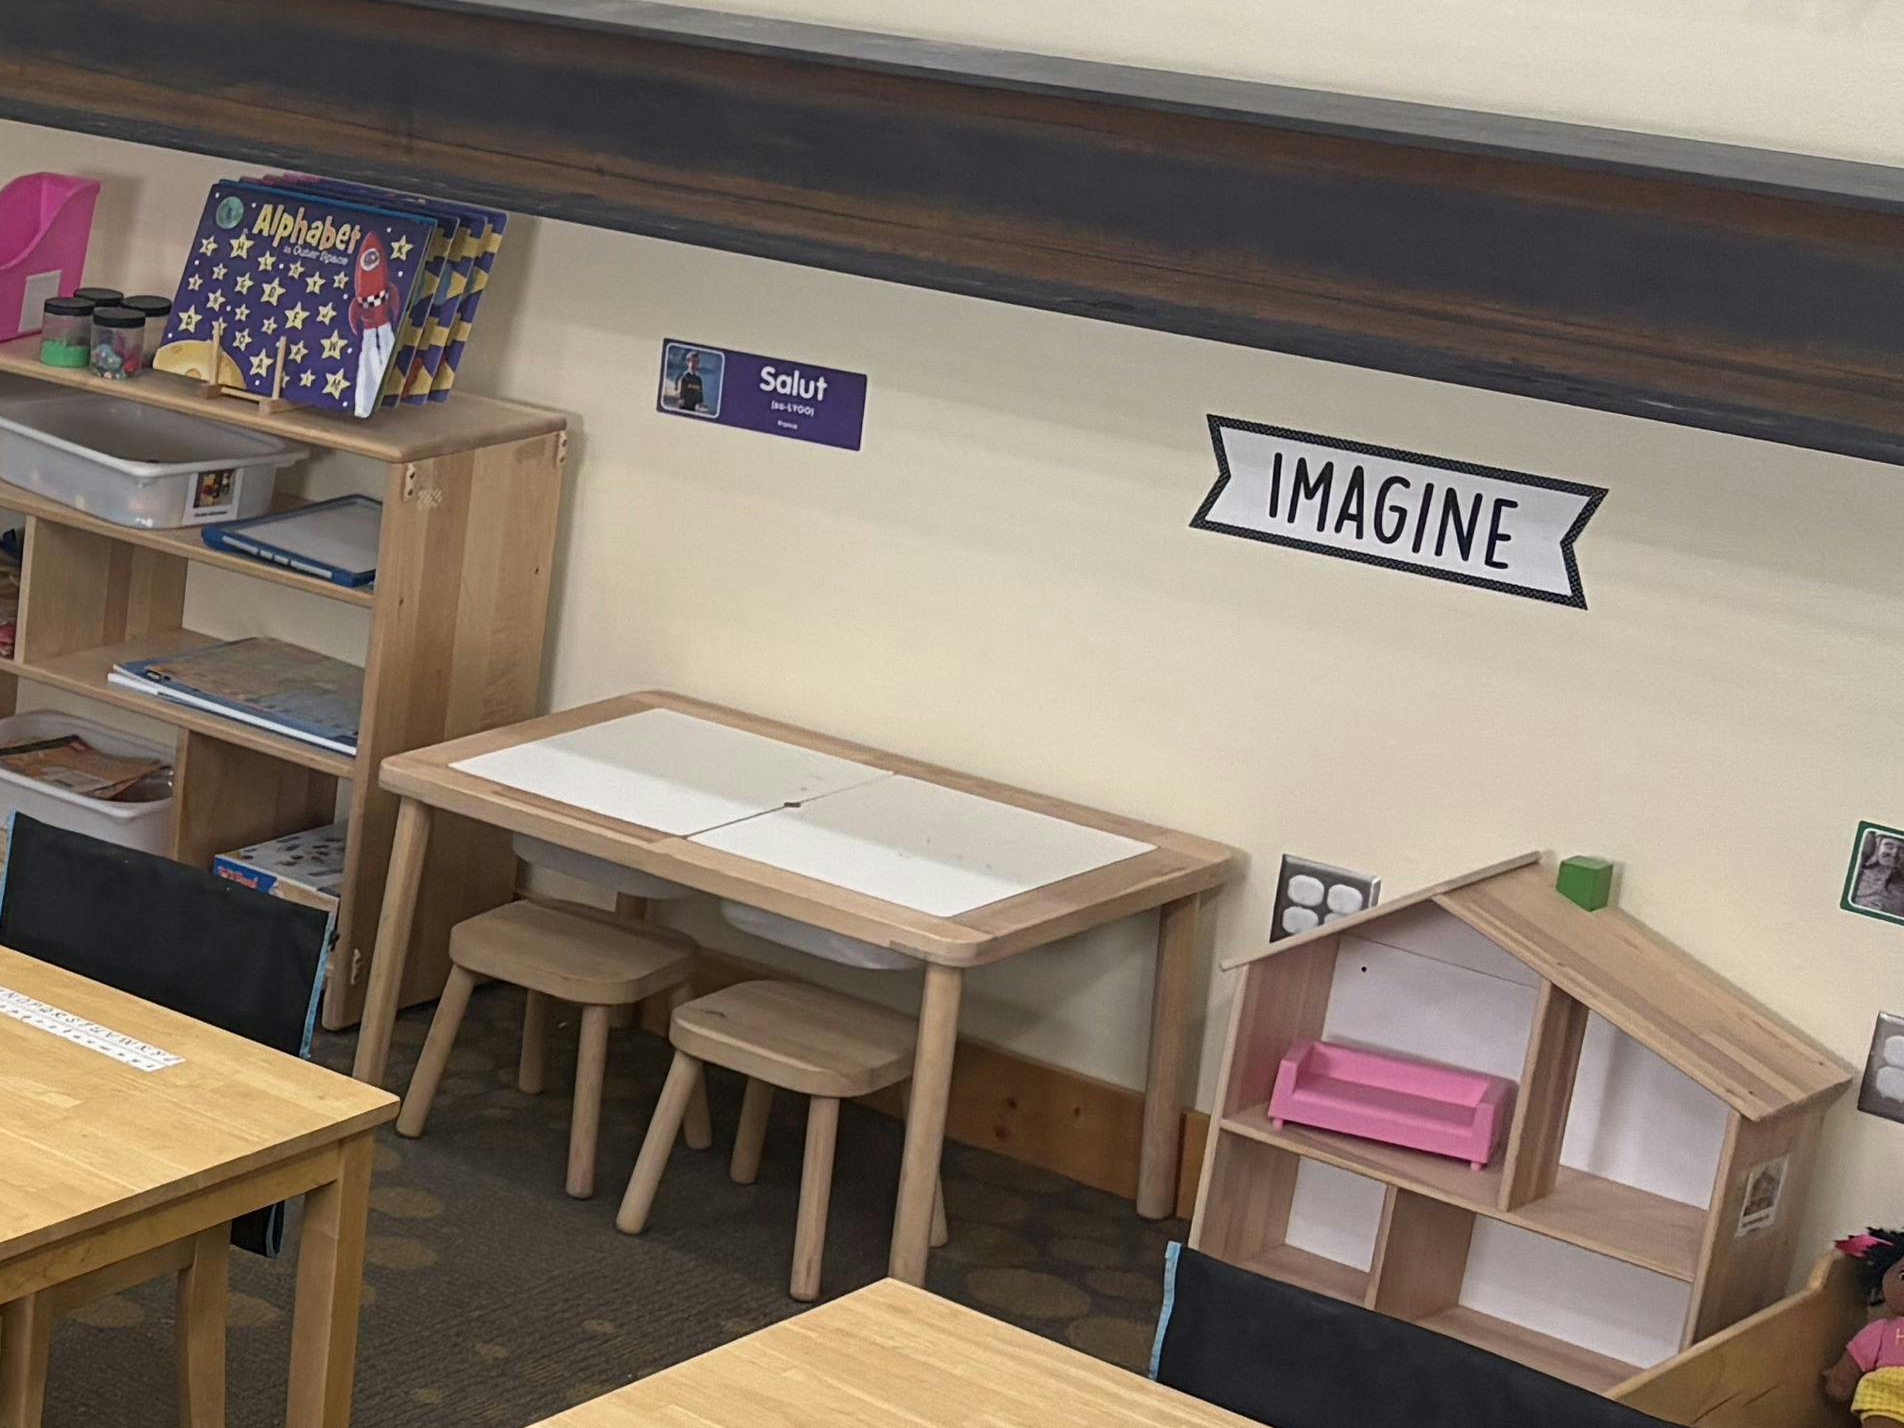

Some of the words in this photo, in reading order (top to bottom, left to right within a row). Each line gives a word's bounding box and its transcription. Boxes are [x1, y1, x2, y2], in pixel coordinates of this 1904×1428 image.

[252, 204, 361, 254] Alphabet
[760, 366, 827, 401] Salut
[1269, 453, 1518, 569] IMAGINE
